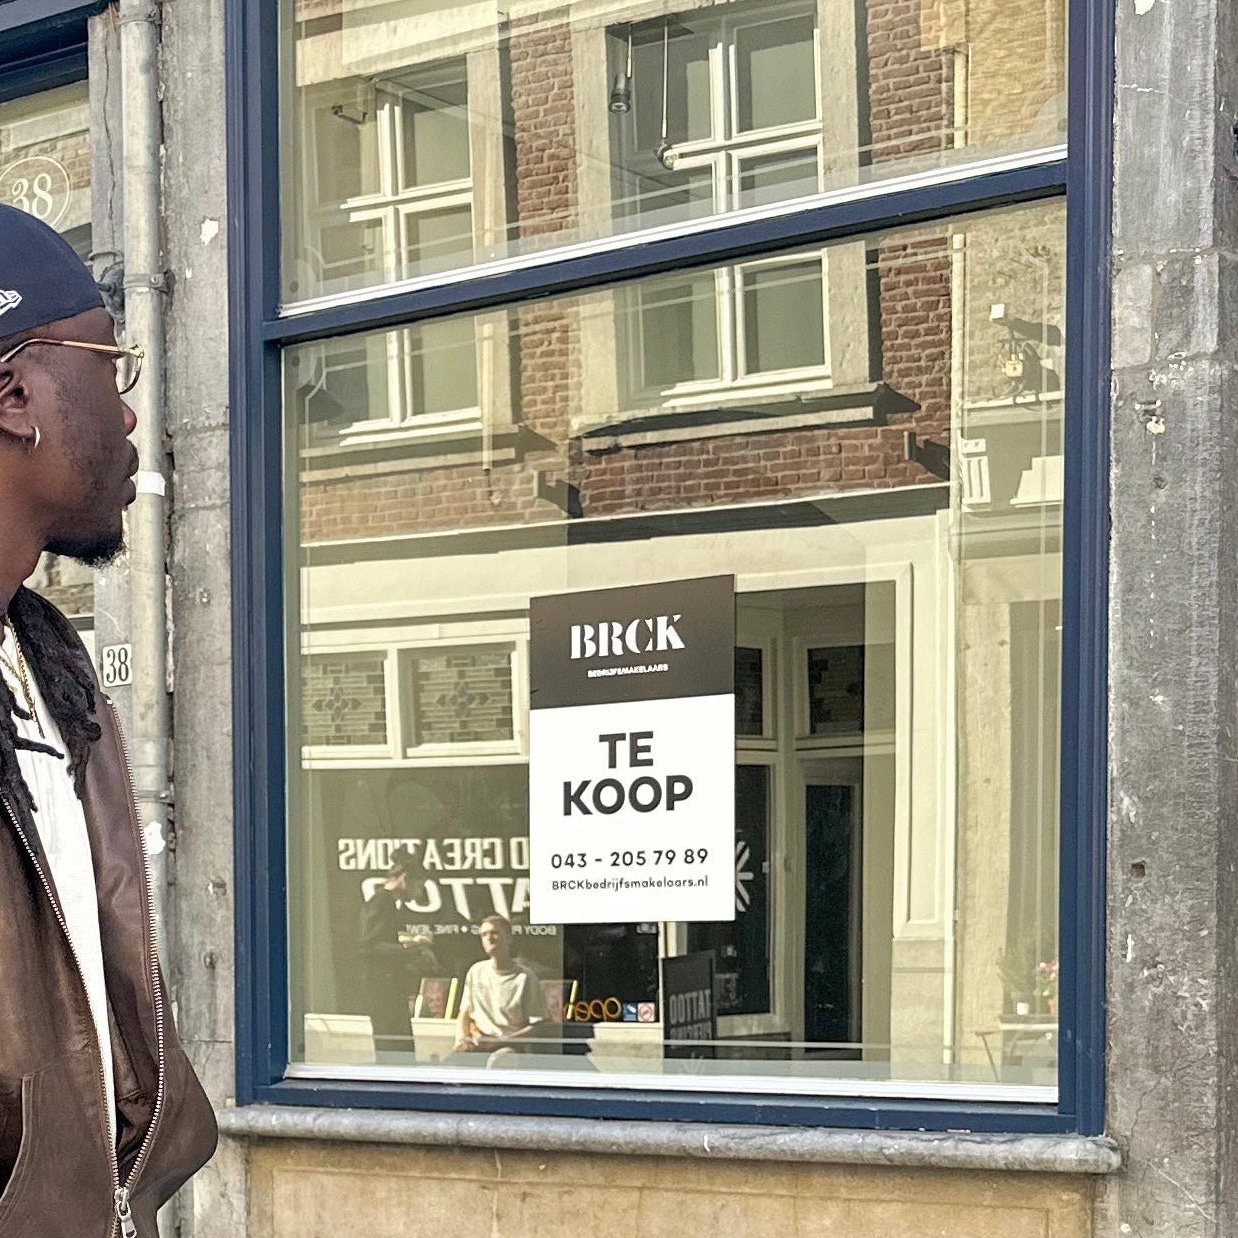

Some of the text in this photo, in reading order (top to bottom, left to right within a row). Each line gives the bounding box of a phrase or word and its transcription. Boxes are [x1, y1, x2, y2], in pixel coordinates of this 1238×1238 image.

[11, 173, 53, 219] 38
[571, 614, 685, 660] BRCK
[106, 647, 129, 684] 38
[599, 730, 654, 769] TE
[563, 774, 694, 817] KOOP
[551, 853, 587, 869] 043
[610, 850, 647, 867] 205
[653, 849, 676, 866] 79
[684, 848, 708, 865] 89
[551, 875, 708, 892] BRCKbedrijfsmakelaars.nl
